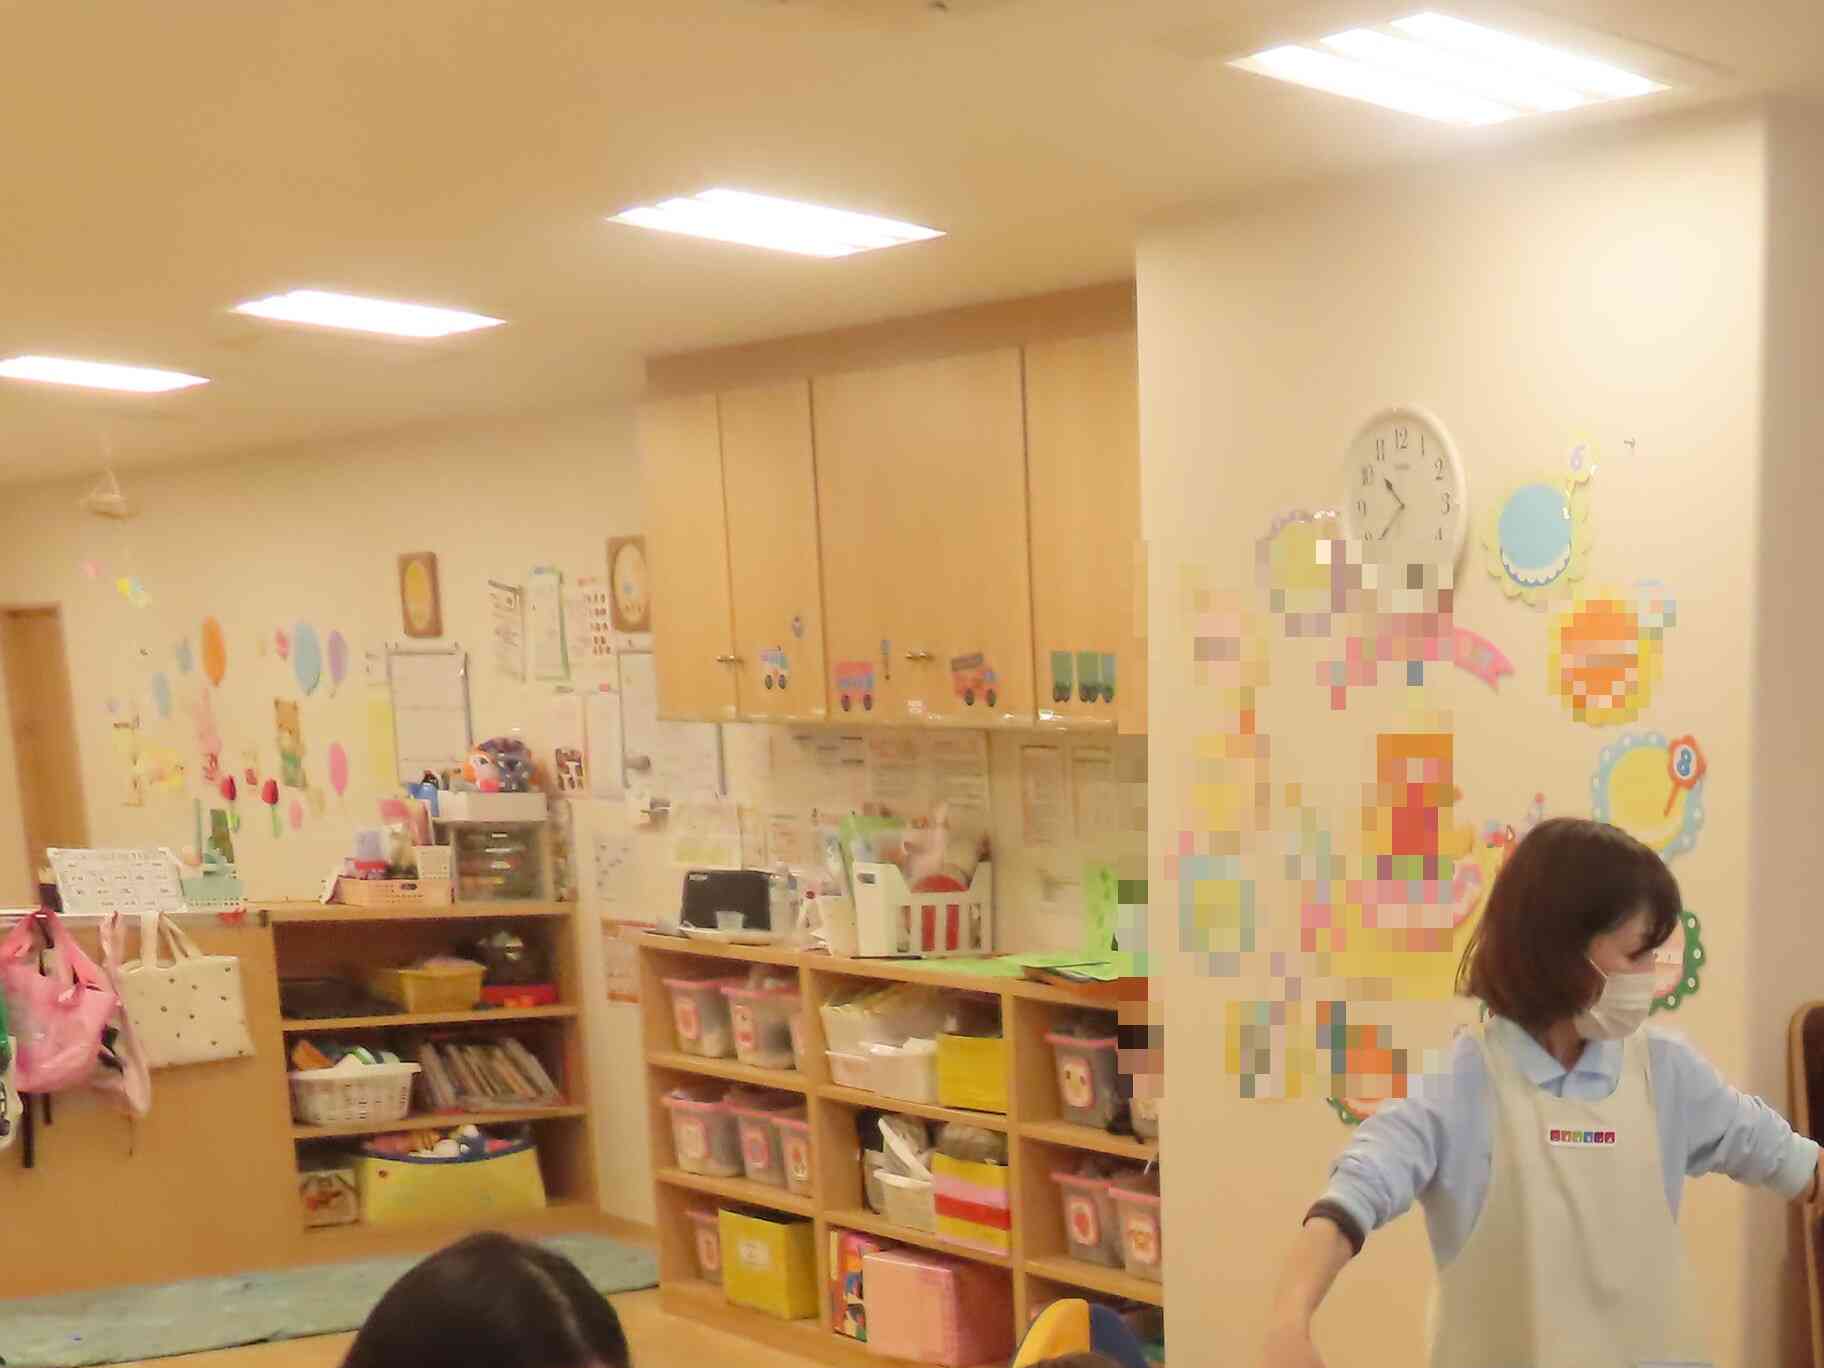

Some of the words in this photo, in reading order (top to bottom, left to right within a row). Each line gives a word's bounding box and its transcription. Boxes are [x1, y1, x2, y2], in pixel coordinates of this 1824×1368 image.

[1393, 426, 1408, 449] 12
[1374, 438, 1386, 461] 11
[1433, 457, 1445, 481] 2
[1356, 499, 1368, 518] 9
[1441, 491, 1452, 515] 3
[1676, 747, 1692, 777] 8
